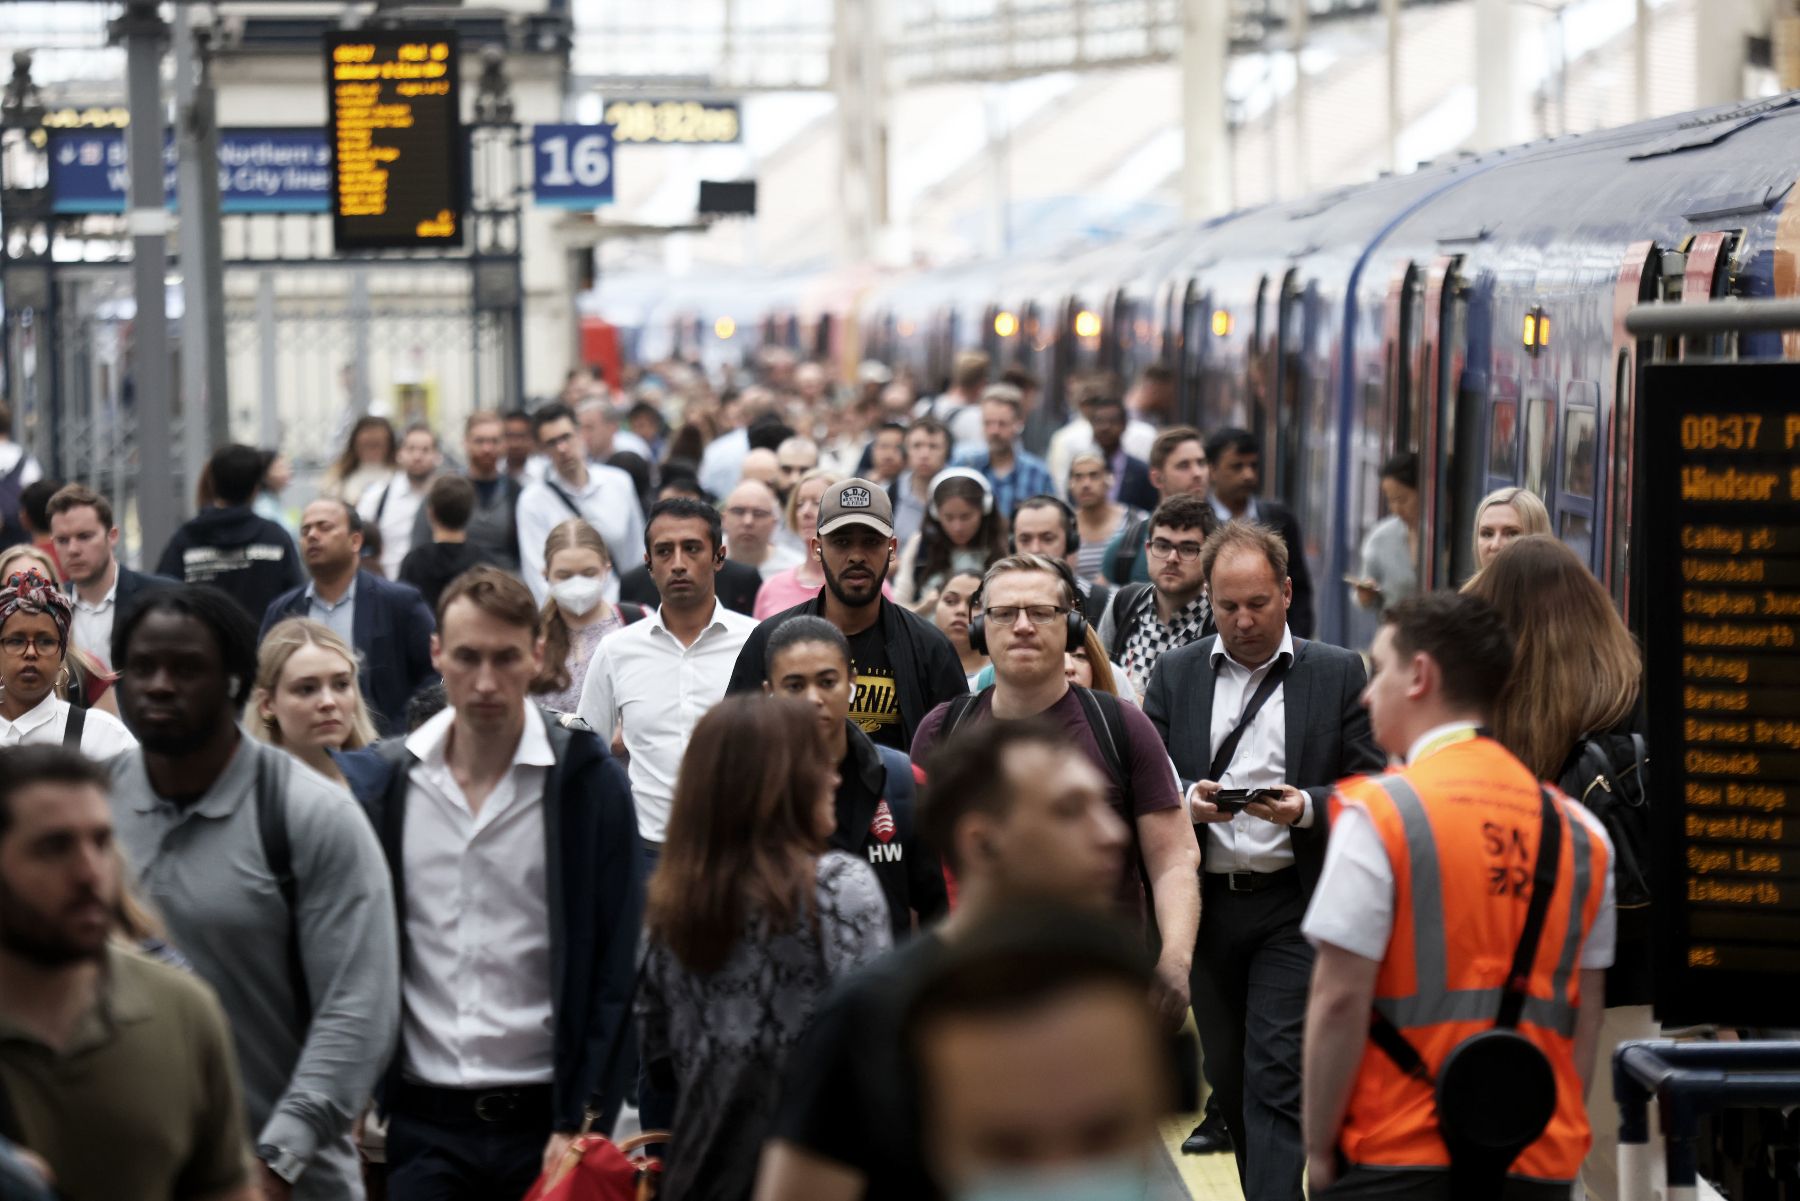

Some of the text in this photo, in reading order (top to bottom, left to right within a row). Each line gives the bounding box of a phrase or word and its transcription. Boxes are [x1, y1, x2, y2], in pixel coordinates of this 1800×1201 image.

[217, 142, 312, 167] Northern
[540, 135, 610, 187] 16
[235, 166, 281, 196] City
[1681, 415, 1762, 450] 08:37
[1681, 466, 1778, 499] Windsor
[1682, 527, 1743, 553] Calling
[1684, 686, 1749, 710] Barnes
[1684, 718, 1749, 742] Barnes
[1727, 783, 1785, 812] Bridge
[1686, 815, 1783, 840] Brentford
[868, 843, 903, 863] HW
[1736, 849, 1781, 872] Lane
[1687, 878, 1780, 904] Isleworth
